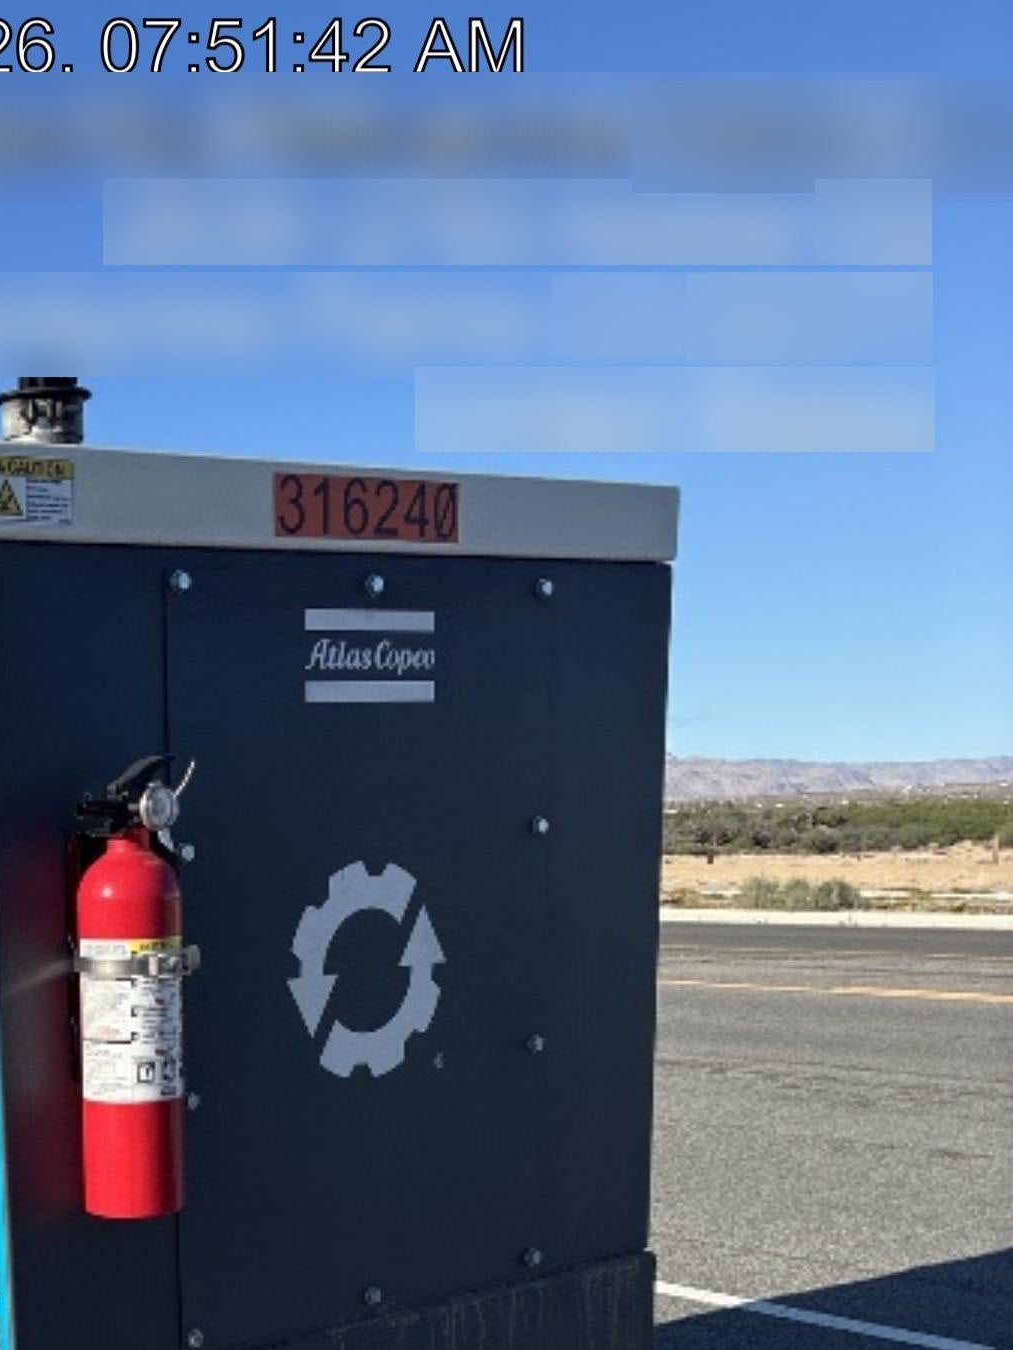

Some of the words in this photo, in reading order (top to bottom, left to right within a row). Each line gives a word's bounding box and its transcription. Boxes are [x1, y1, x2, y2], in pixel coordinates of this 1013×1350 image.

[279, 474, 459, 538] 316240
[305, 638, 372, 670] Atlas
[374, 638, 435, 676] Copco
